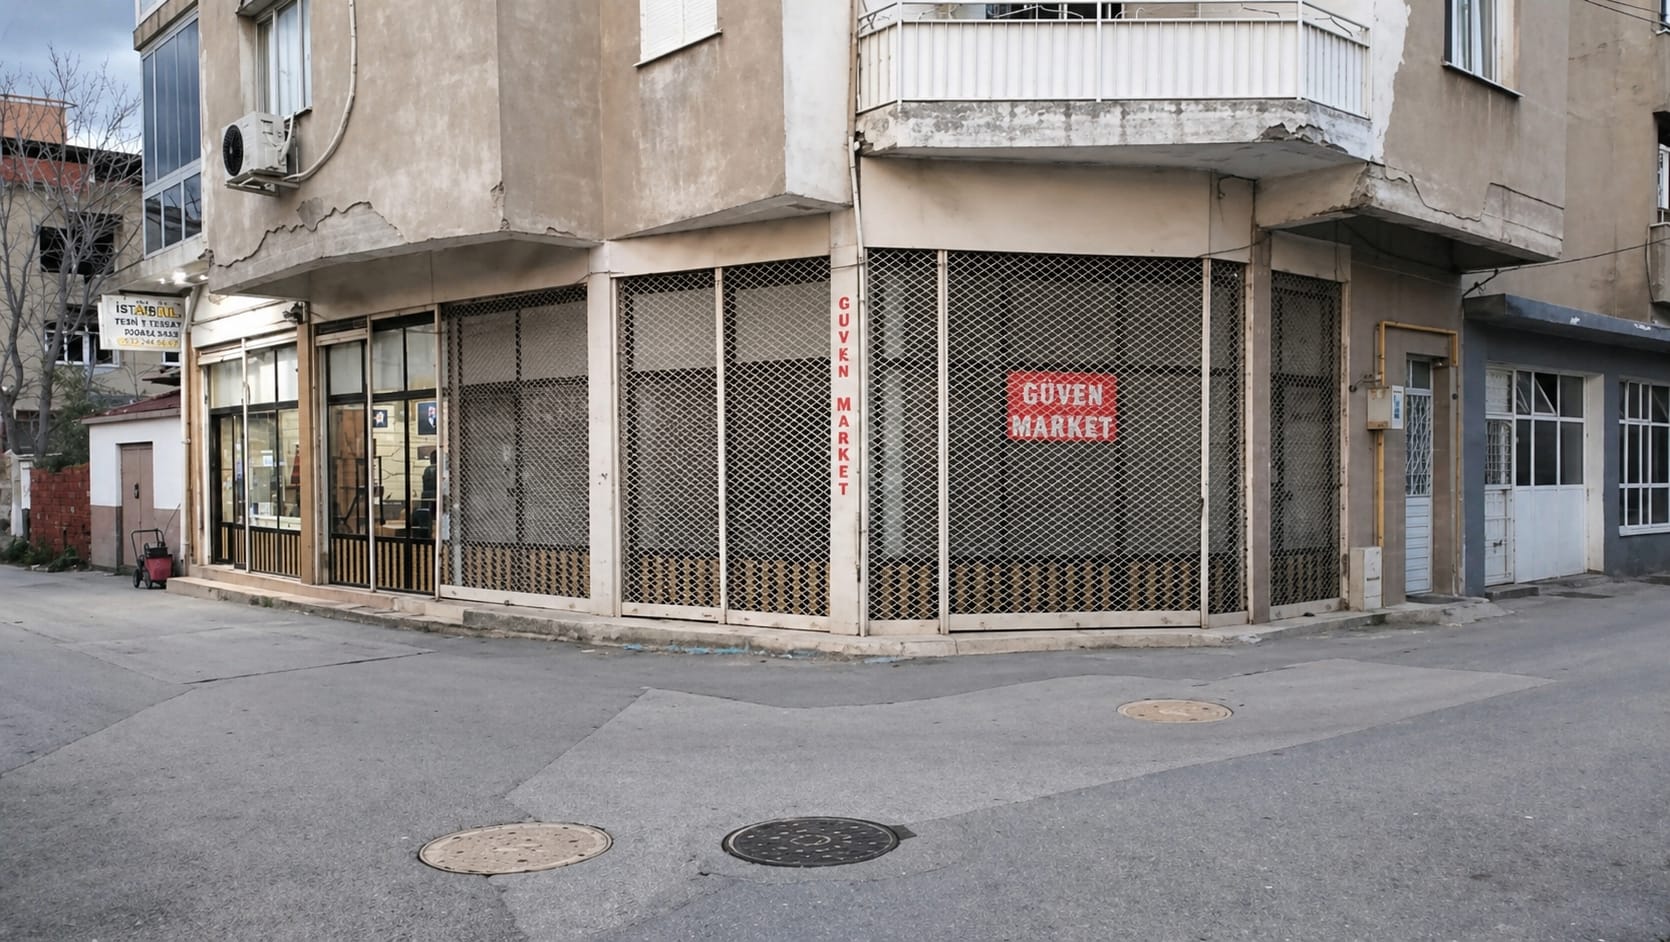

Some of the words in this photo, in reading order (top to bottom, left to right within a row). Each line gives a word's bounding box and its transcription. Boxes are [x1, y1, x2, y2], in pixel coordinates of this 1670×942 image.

[1023, 378, 1103, 406] GÜVEN
[1011, 414, 1113, 438] MARKET
[836, 396, 851, 495] MARKET
